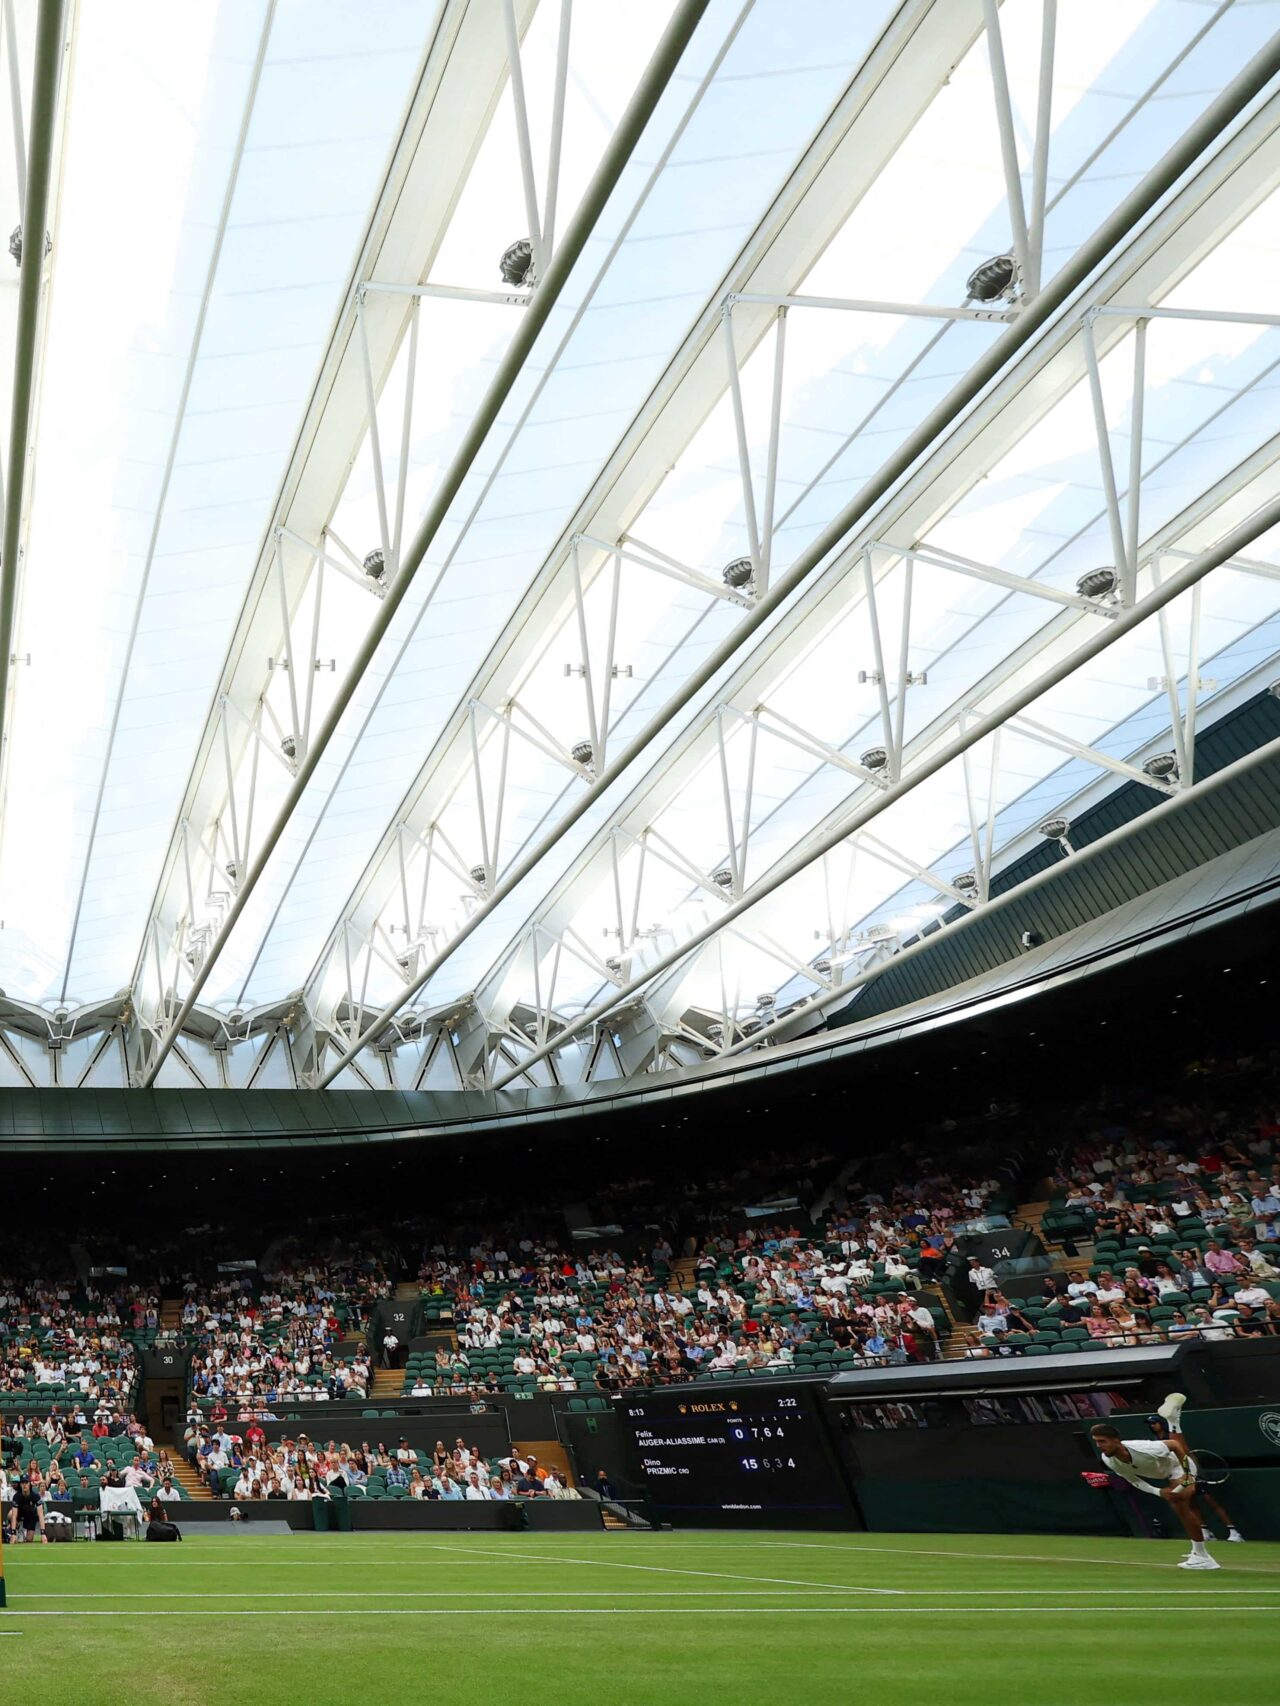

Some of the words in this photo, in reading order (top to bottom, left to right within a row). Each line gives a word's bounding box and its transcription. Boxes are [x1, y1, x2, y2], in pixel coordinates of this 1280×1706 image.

[991, 1246, 1010, 1259] 34
[393, 1313, 405, 1321] 32
[163, 1356, 173, 1364] 30
[777, 1398, 797, 1407] 2:22
[691, 1403, 726, 1413] ROLEX
[635, 1430, 653, 1438] Felix
[734, 1428, 744, 1439] 0
[751, 1428, 758, 1438] 7
[763, 1427, 772, 1438] 6
[776, 1427, 785, 1438] 4
[638, 1437, 706, 1447] AUGER-ALIASSIME
[643, 1458, 661, 1466] Dino
[741, 1458, 758, 1469] 15
[762, 1458, 770, 1468] 6
[774, 1457, 783, 1468] 3
[787, 1457, 796, 1468] 4
[646, 1466, 677, 1475] PRIZMIC
